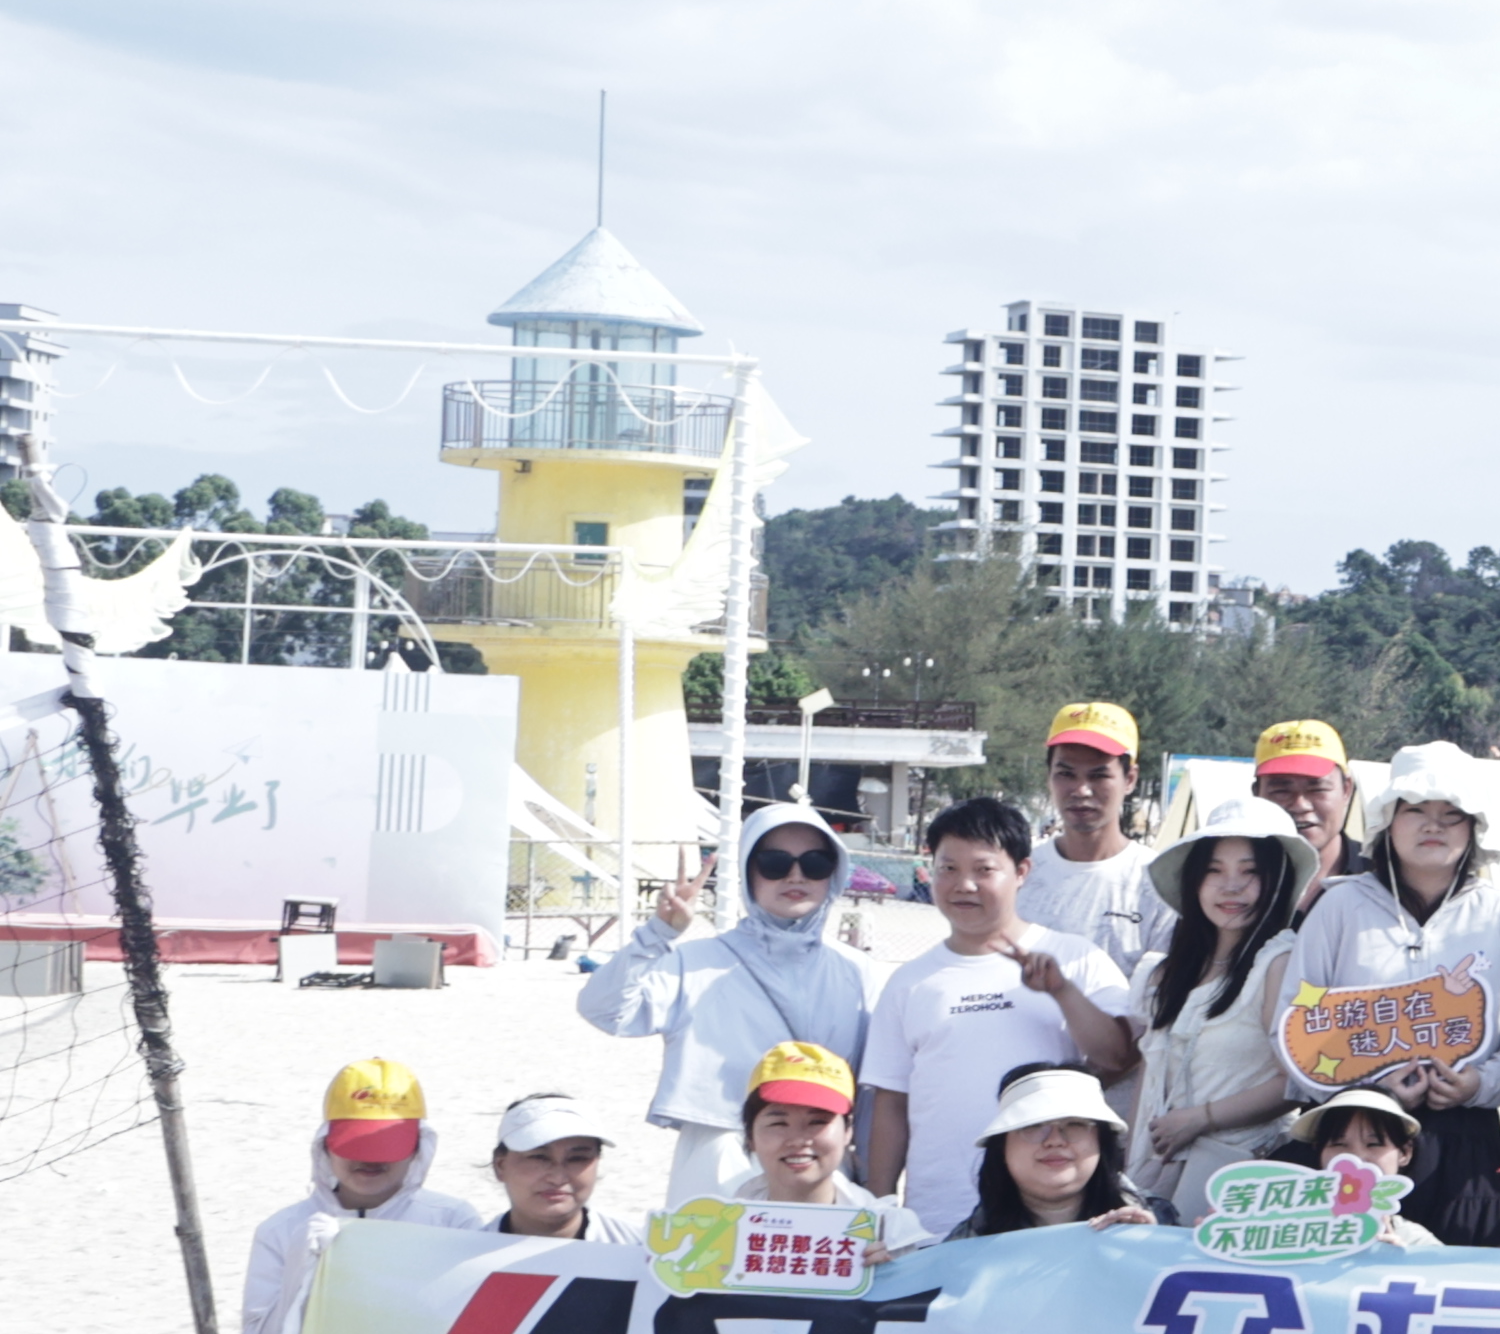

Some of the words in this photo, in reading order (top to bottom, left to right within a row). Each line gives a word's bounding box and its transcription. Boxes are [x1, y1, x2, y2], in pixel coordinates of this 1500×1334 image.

[1305, 991, 1435, 1034] 出游自在
[1351, 1017, 1472, 1056] 迷人可爱
[1222, 1175, 1337, 1214] 等风来
[747, 1233, 856, 1257] 世界那么大
[1212, 1219, 1357, 1253] 不如追风去
[744, 1254, 853, 1278] 我想去看看
